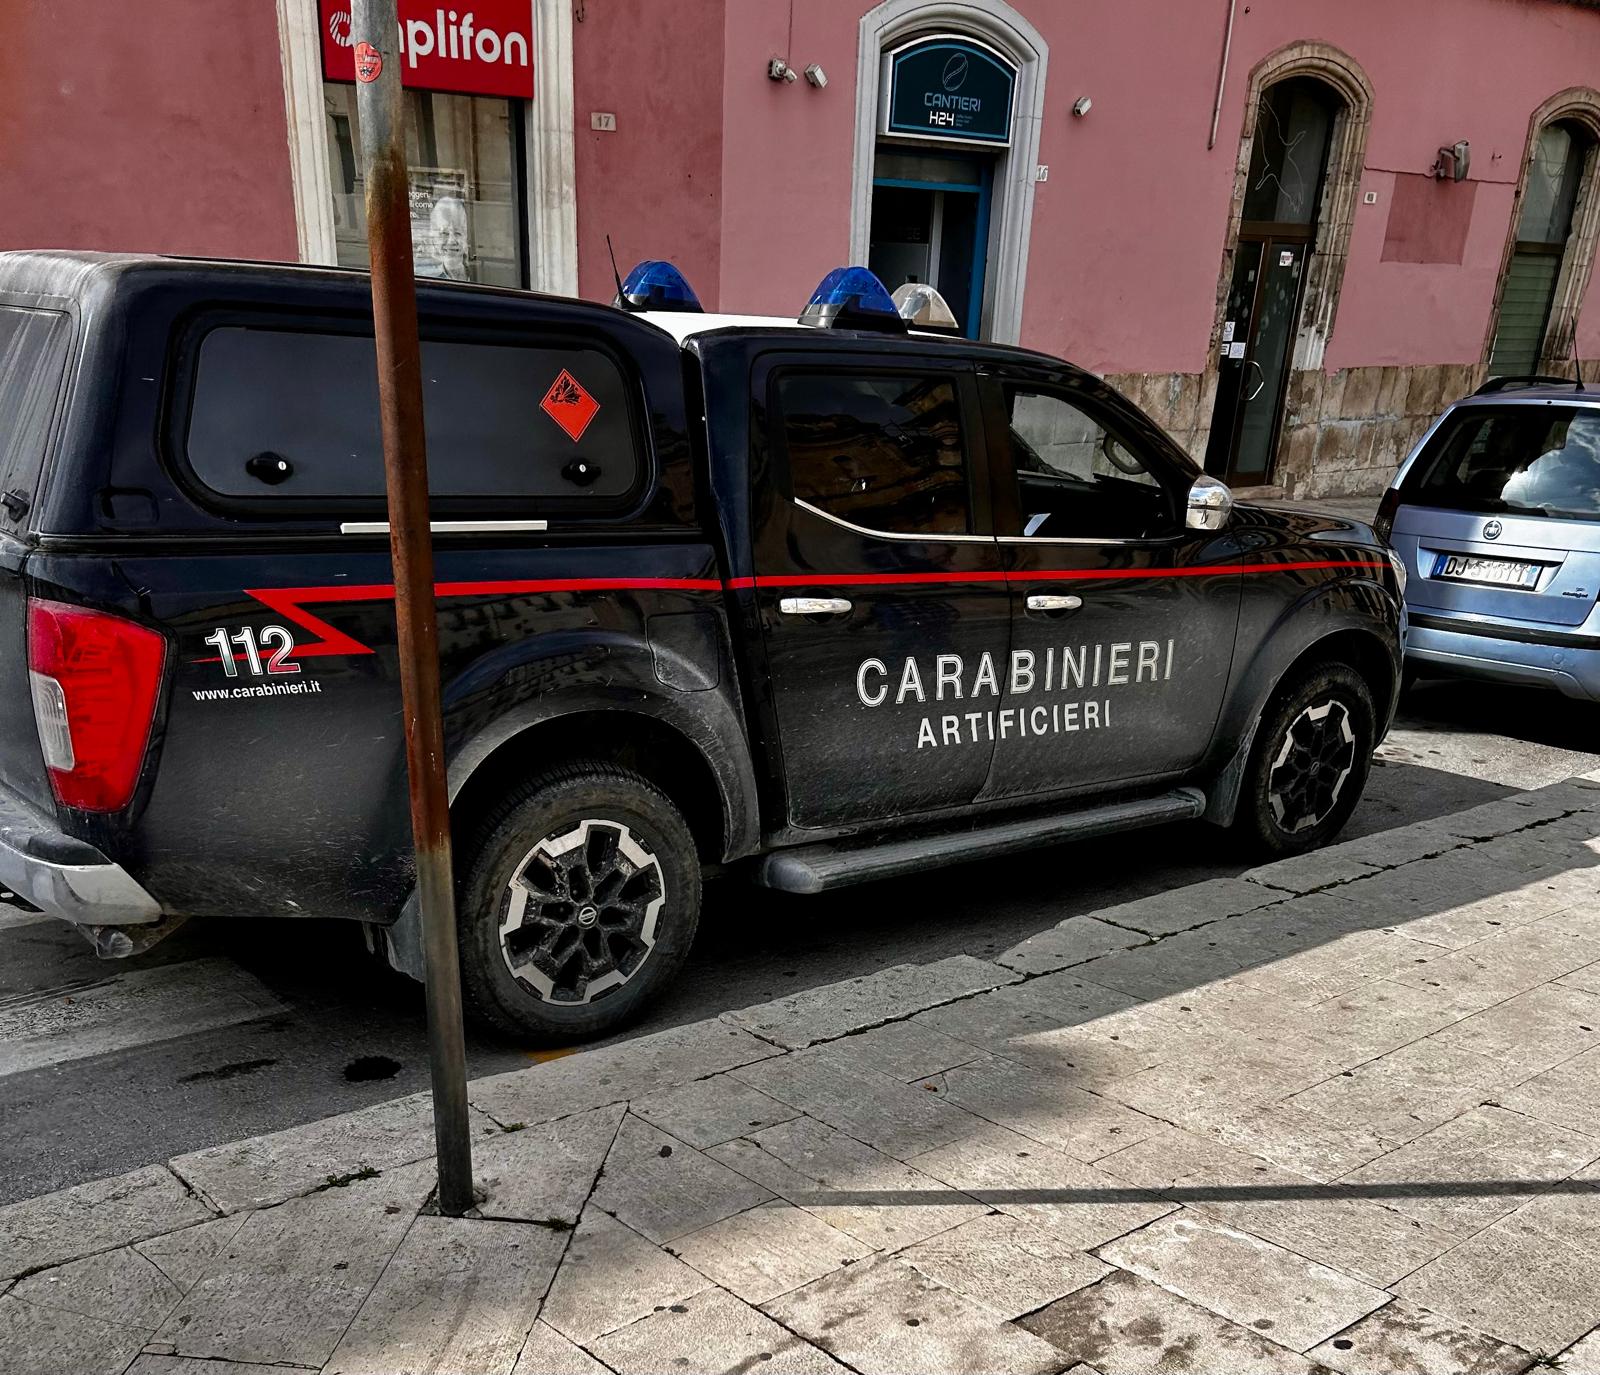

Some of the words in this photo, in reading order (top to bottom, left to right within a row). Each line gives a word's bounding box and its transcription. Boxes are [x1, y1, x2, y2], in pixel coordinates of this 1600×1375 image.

[329, 9, 528, 69] aplifon
[924, 92, 981, 112] CANTIERI
[929, 111, 955, 126] H24
[597, 114, 611, 128] 17
[204, 625, 301, 677] 112
[192, 680, 322, 701] www.carabinieri.it
[856, 639, 1175, 707] CARABINIERI
[917, 700, 1111, 749] ARTIFICIERI
